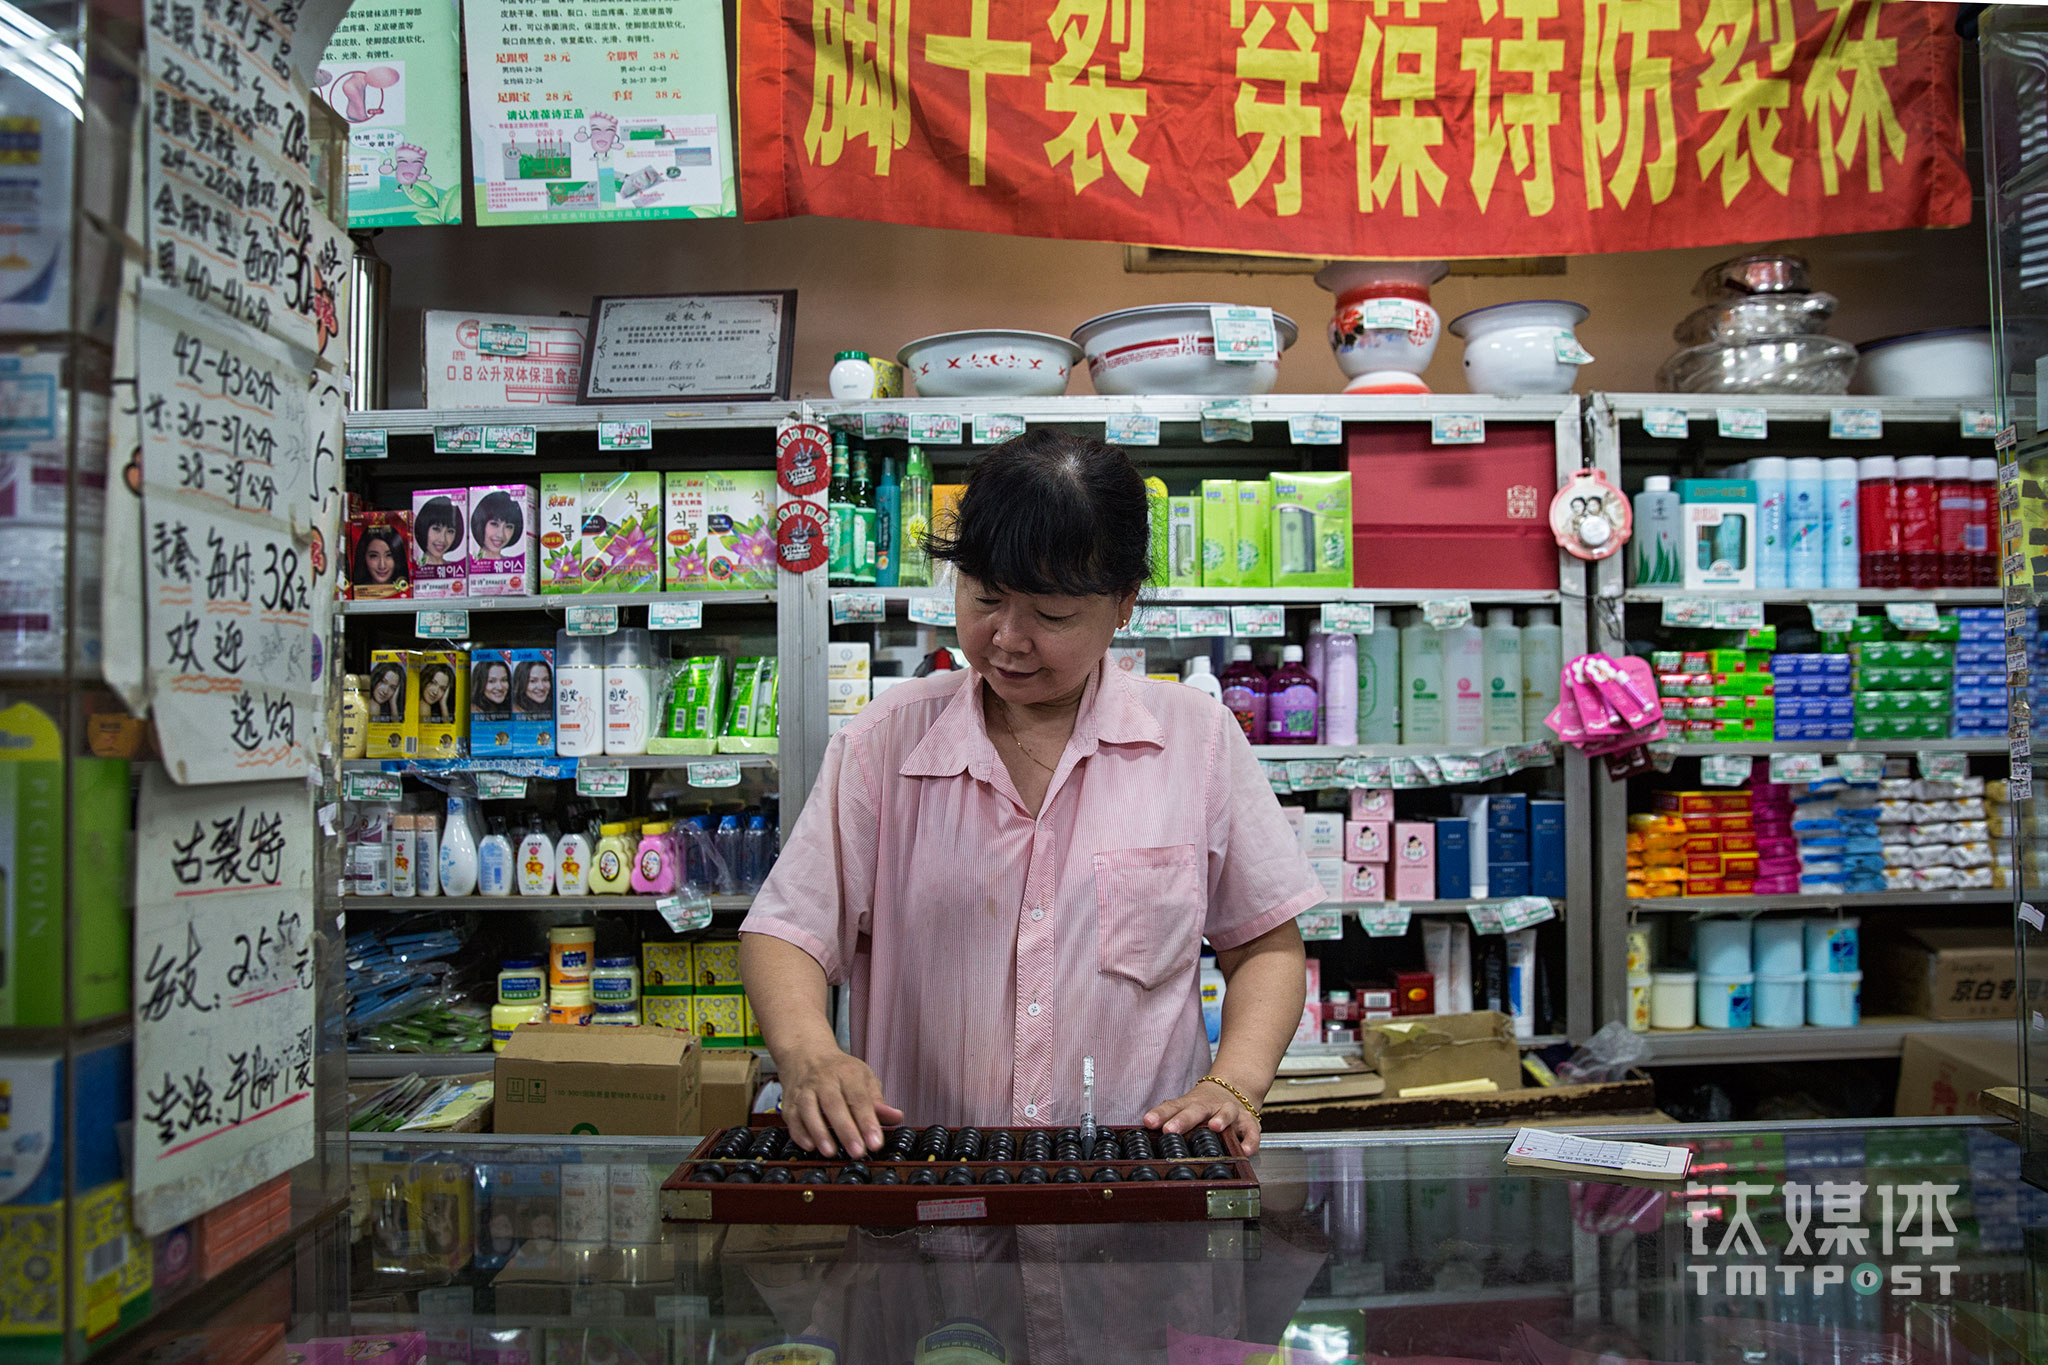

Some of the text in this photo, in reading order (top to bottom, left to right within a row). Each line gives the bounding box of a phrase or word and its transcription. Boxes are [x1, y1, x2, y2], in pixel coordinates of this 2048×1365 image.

[496, 53, 529, 64] 足跟型
[607, 51, 638, 63] 全脚型
[497, 92, 530, 104] 足跟宝
